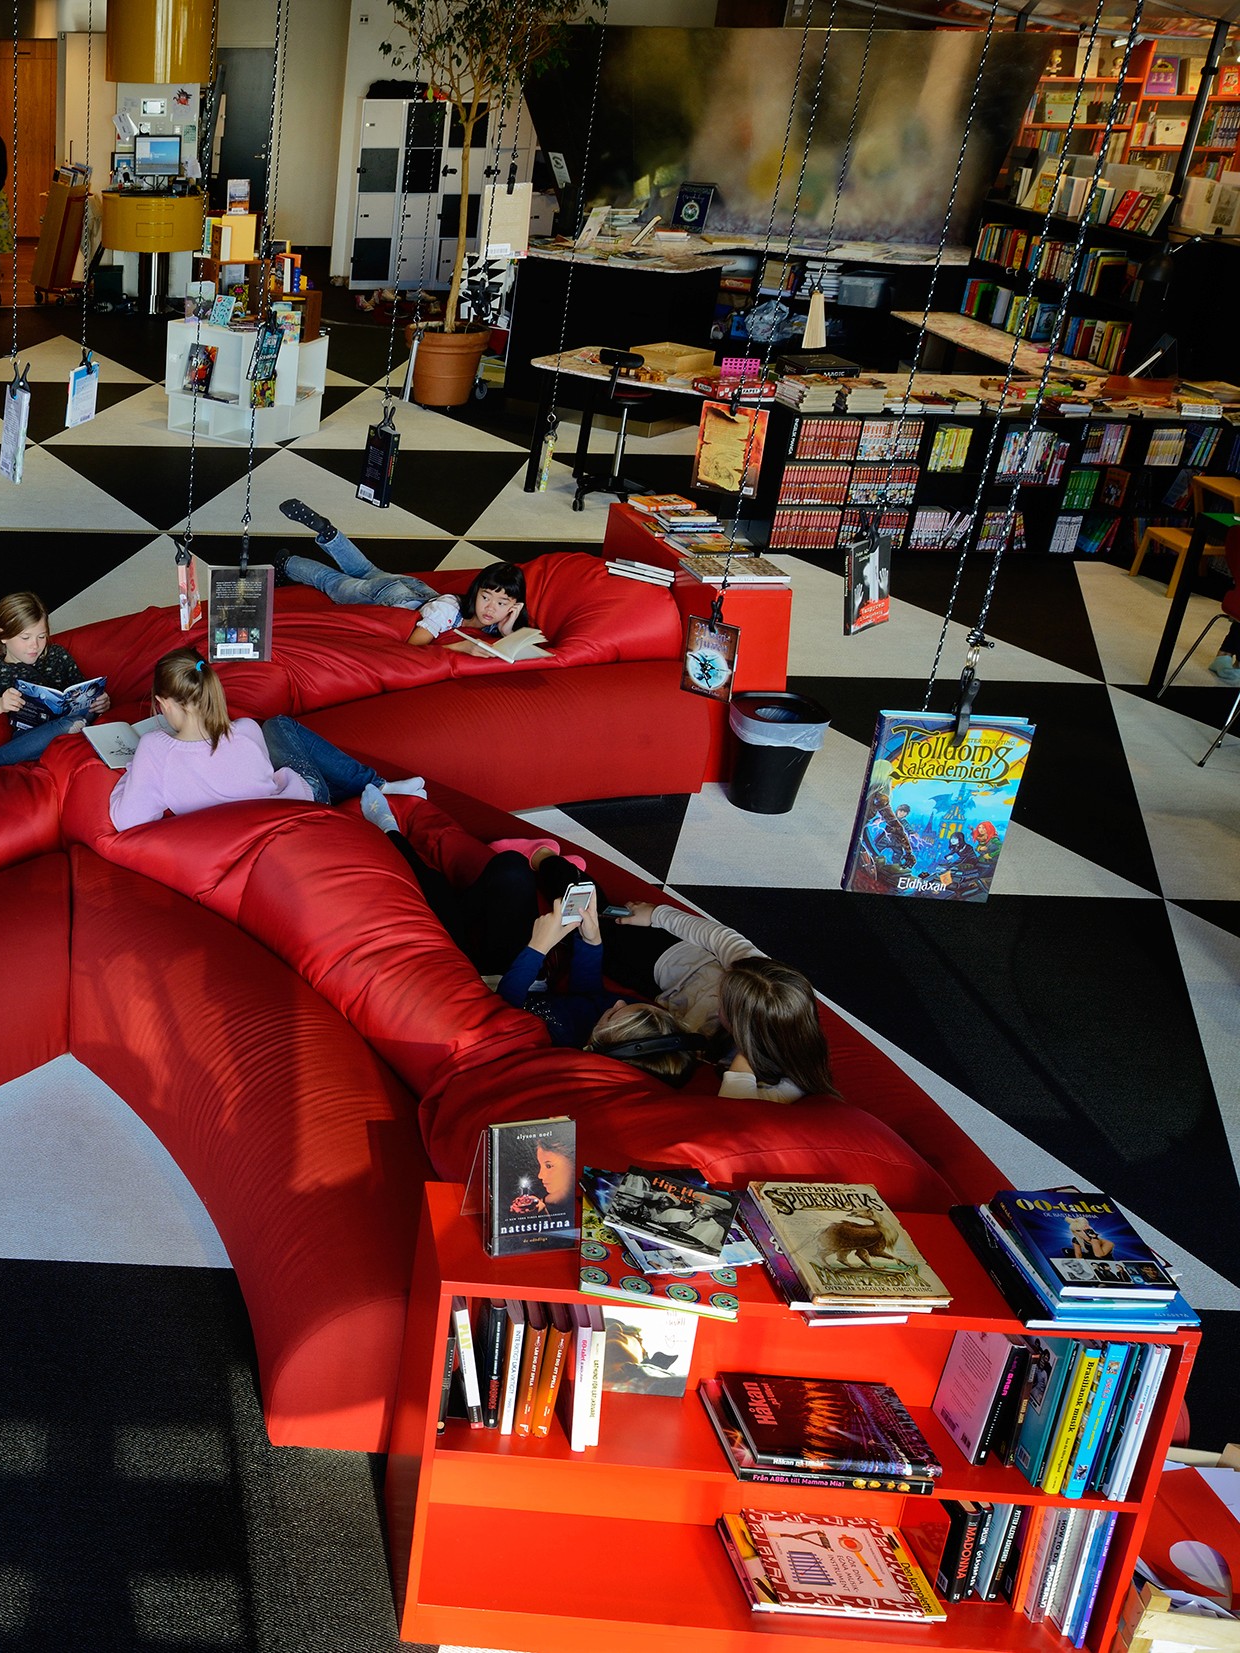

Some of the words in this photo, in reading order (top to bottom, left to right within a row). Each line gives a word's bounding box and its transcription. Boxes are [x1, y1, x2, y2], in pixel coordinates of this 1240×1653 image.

[889, 724, 1013, 784] Trolldoms
[907, 761, 991, 780] akademien
[896, 876, 948, 893] Eldhäxan
[788, 1186, 840, 1194] ARTHUR
[500, 1218, 571, 1235] nattstjärna
[458, 1325, 472, 1350] PLAY
[1002, 1372, 1014, 1396] GAGA
[1076, 1361, 1095, 1407] Brasiliansk
[742, 1381, 779, 1426] Håkan
[1068, 1407, 1081, 1433] musik
[772, 1457, 794, 1466] Håkan
[752, 1474, 768, 1483] Från
[769, 1475, 789, 1483] ABBA
[790, 1476, 801, 1484] till
[801, 1477, 828, 1486] Mamma
[828, 1478, 845, 1487] Mia!
[1012, 1509, 1021, 1525] PETTER
[1008, 1525, 1016, 1539] ALEXIS
[1058, 1519, 1068, 1537] HOW
[955, 1525, 978, 1580] MADONNA
[1055, 1539, 1062, 1551] TO
[1052, 1552, 1059, 1562] DJ
[828, 1553, 849, 1593] INSTRUMENT
[853, 1568, 864, 1584] DINA
[900, 1562, 913, 1583] Den
[907, 1582, 933, 1614] komplette
[1039, 1564, 1056, 1608] (PROPERLY)
